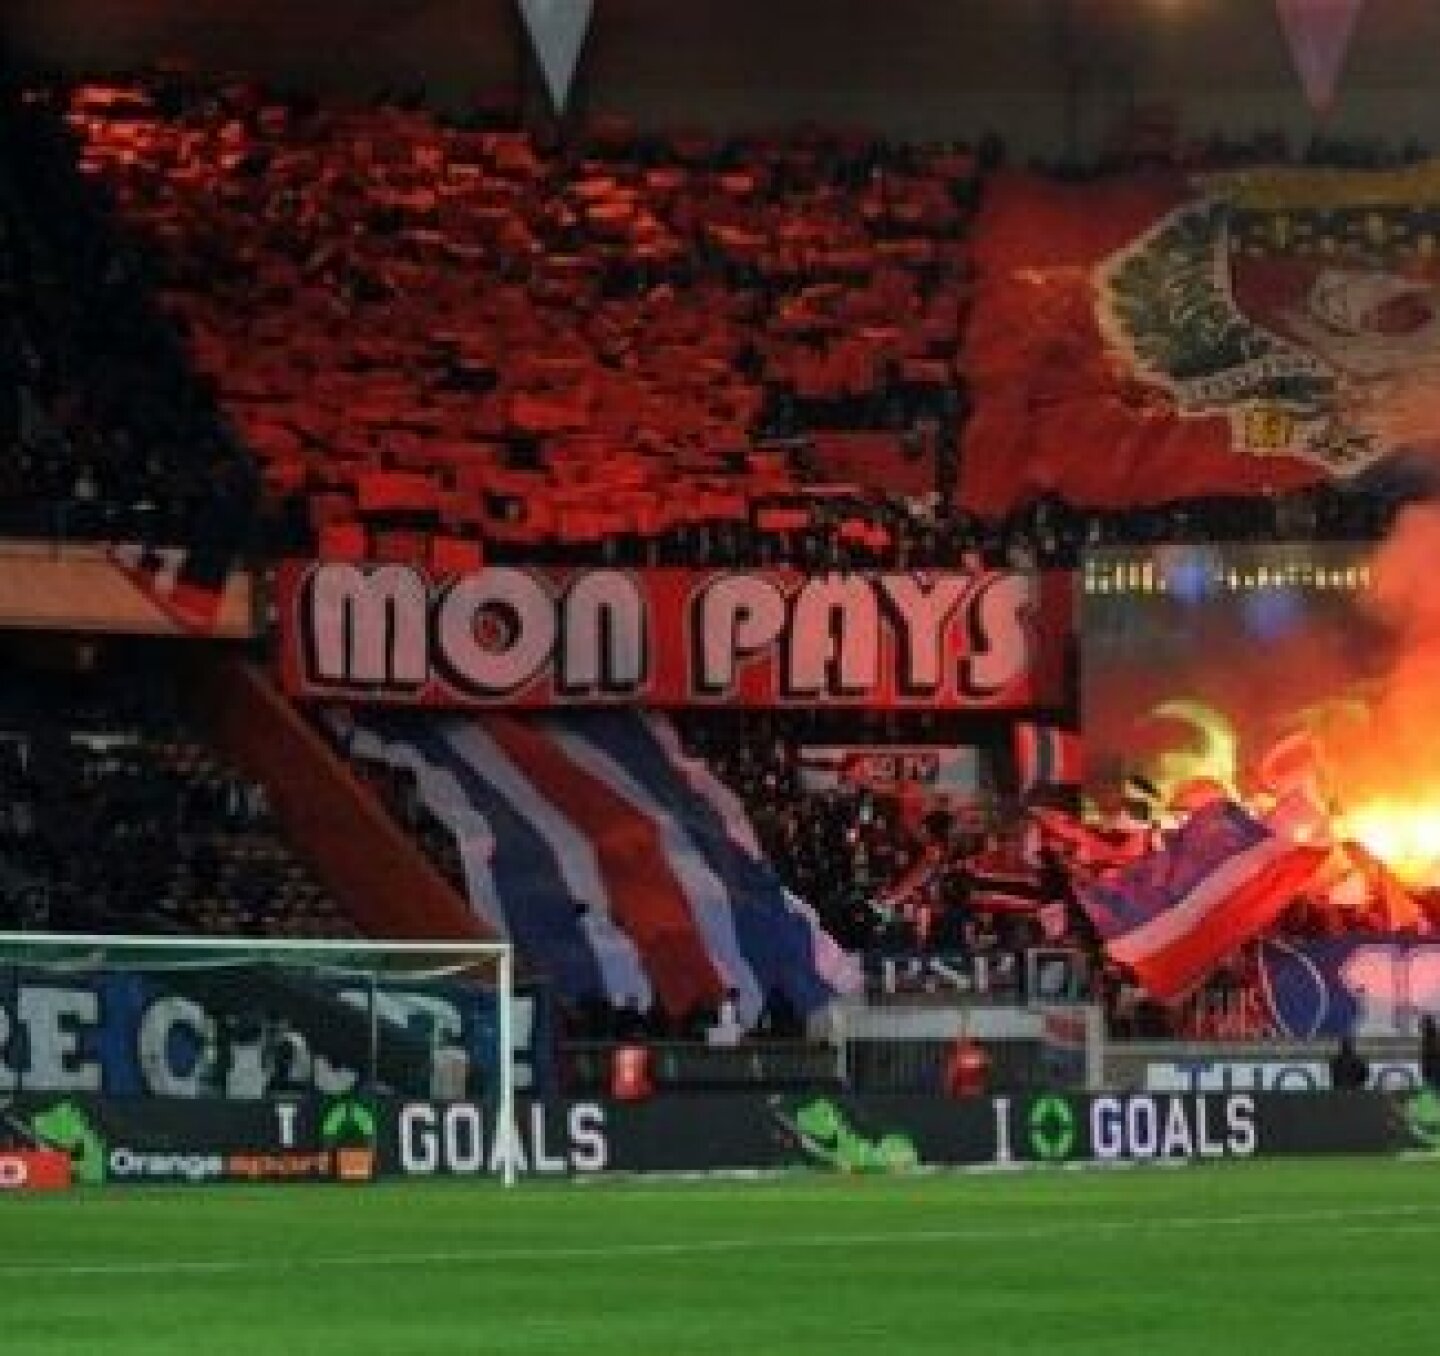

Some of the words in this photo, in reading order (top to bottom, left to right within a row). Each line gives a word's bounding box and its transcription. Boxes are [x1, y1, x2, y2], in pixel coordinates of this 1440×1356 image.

[304, 564, 652, 694] MON
[696, 570, 1040, 694] PAYS
[401, 1102, 609, 1174] GOALS
[1090, 1095, 1258, 1158] GOALS
